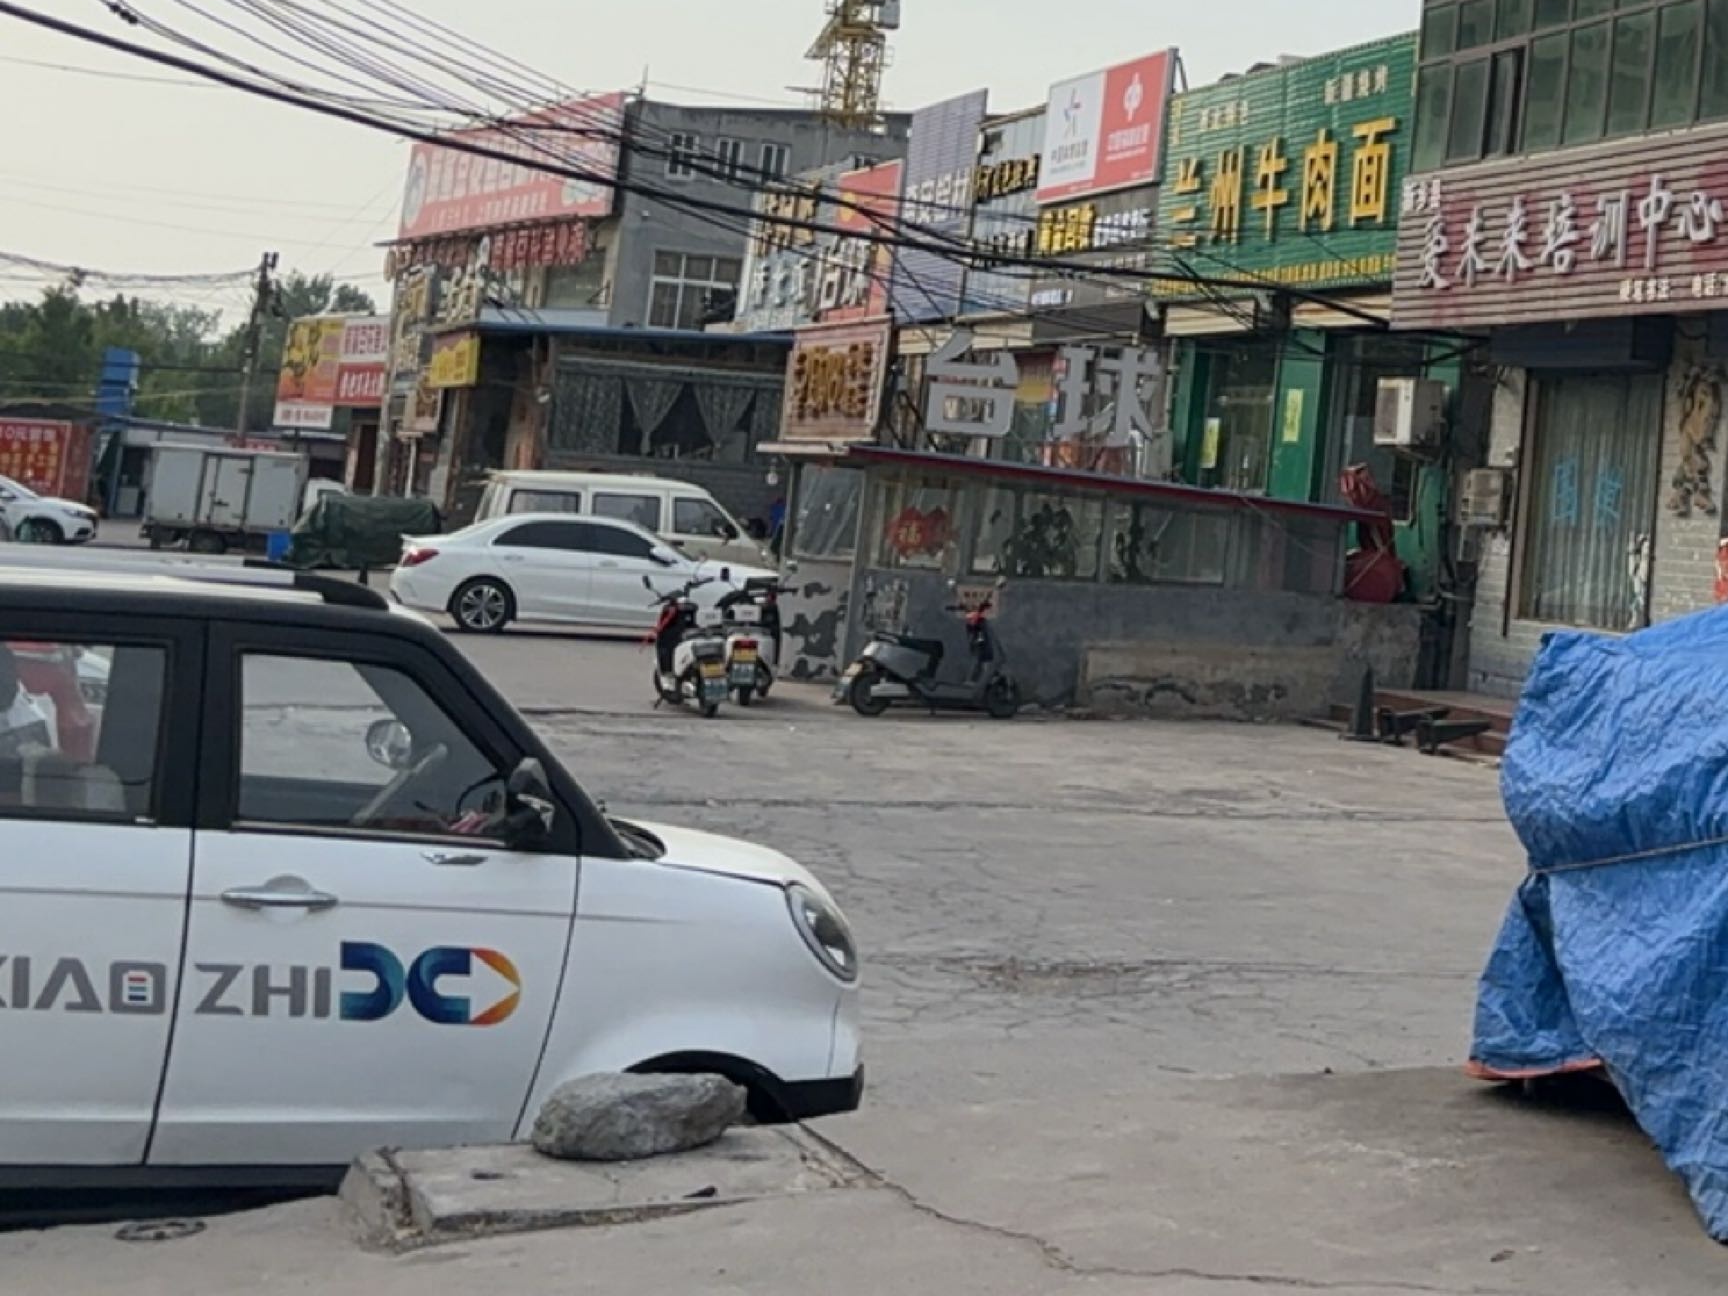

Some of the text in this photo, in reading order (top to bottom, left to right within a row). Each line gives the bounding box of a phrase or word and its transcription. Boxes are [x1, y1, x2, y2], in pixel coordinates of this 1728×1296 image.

[1167, 115, 1398, 251] 兰州牛肉面
[925, 325, 1161, 447] 台球
[194, 962, 332, 1018] ZHI
